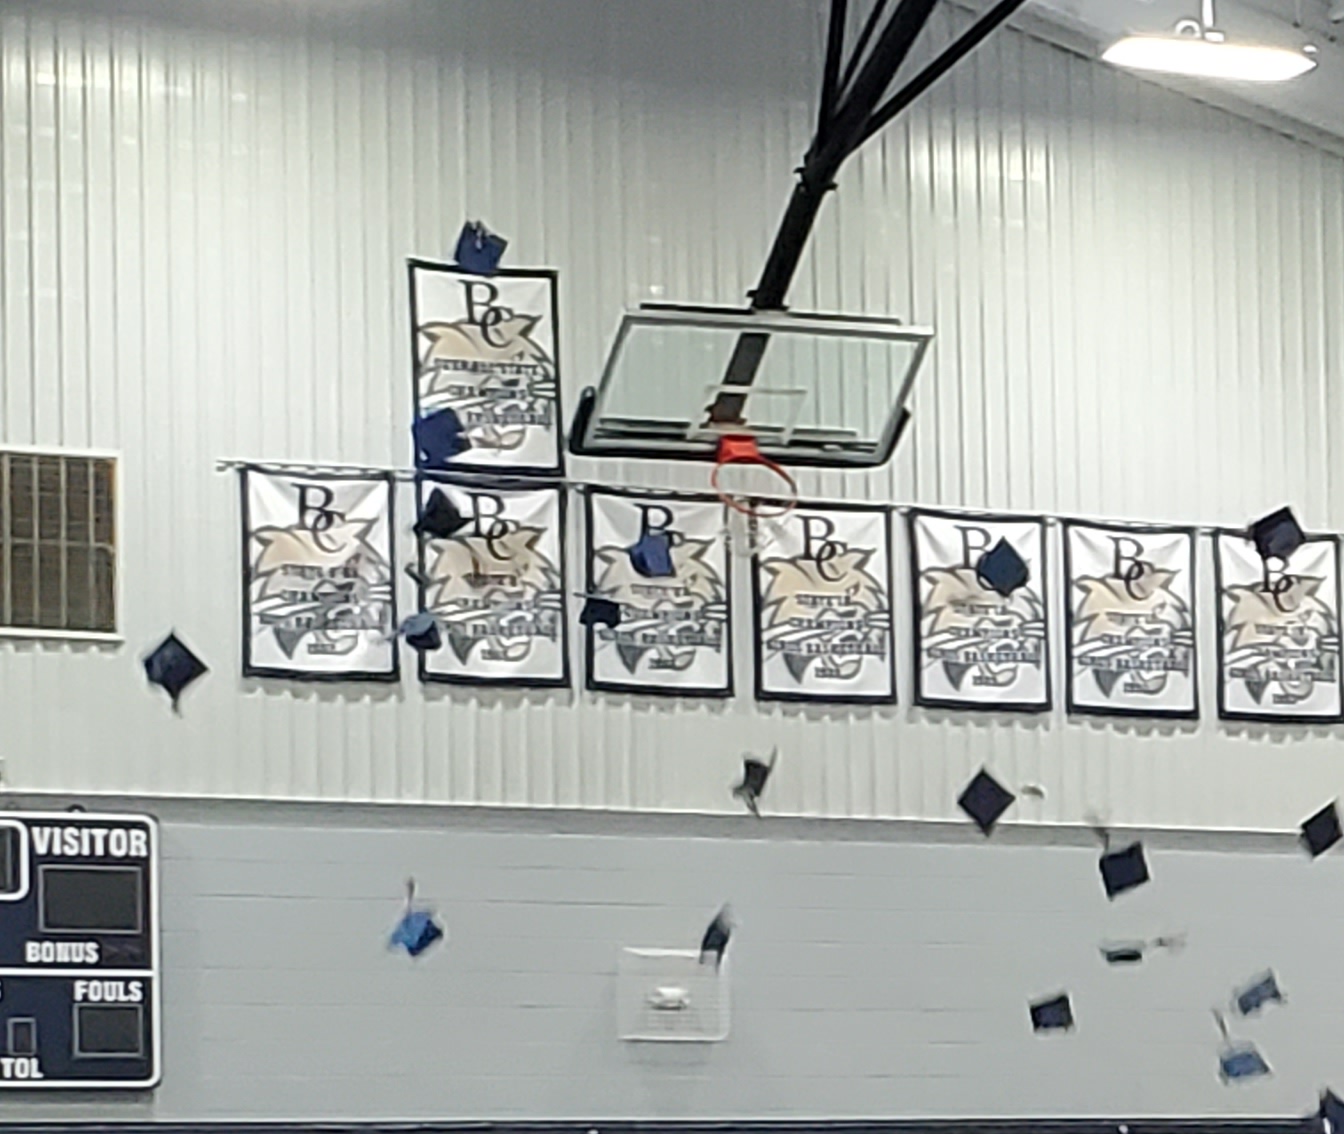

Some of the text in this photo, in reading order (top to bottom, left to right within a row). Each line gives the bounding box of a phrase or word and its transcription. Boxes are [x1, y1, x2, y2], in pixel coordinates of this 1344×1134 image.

[32, 827, 148, 858] VISITOR
[25, 942, 100, 964] BONUS
[74, 981, 144, 1002] FOULS
[1, 1057, 44, 1079] TOL
